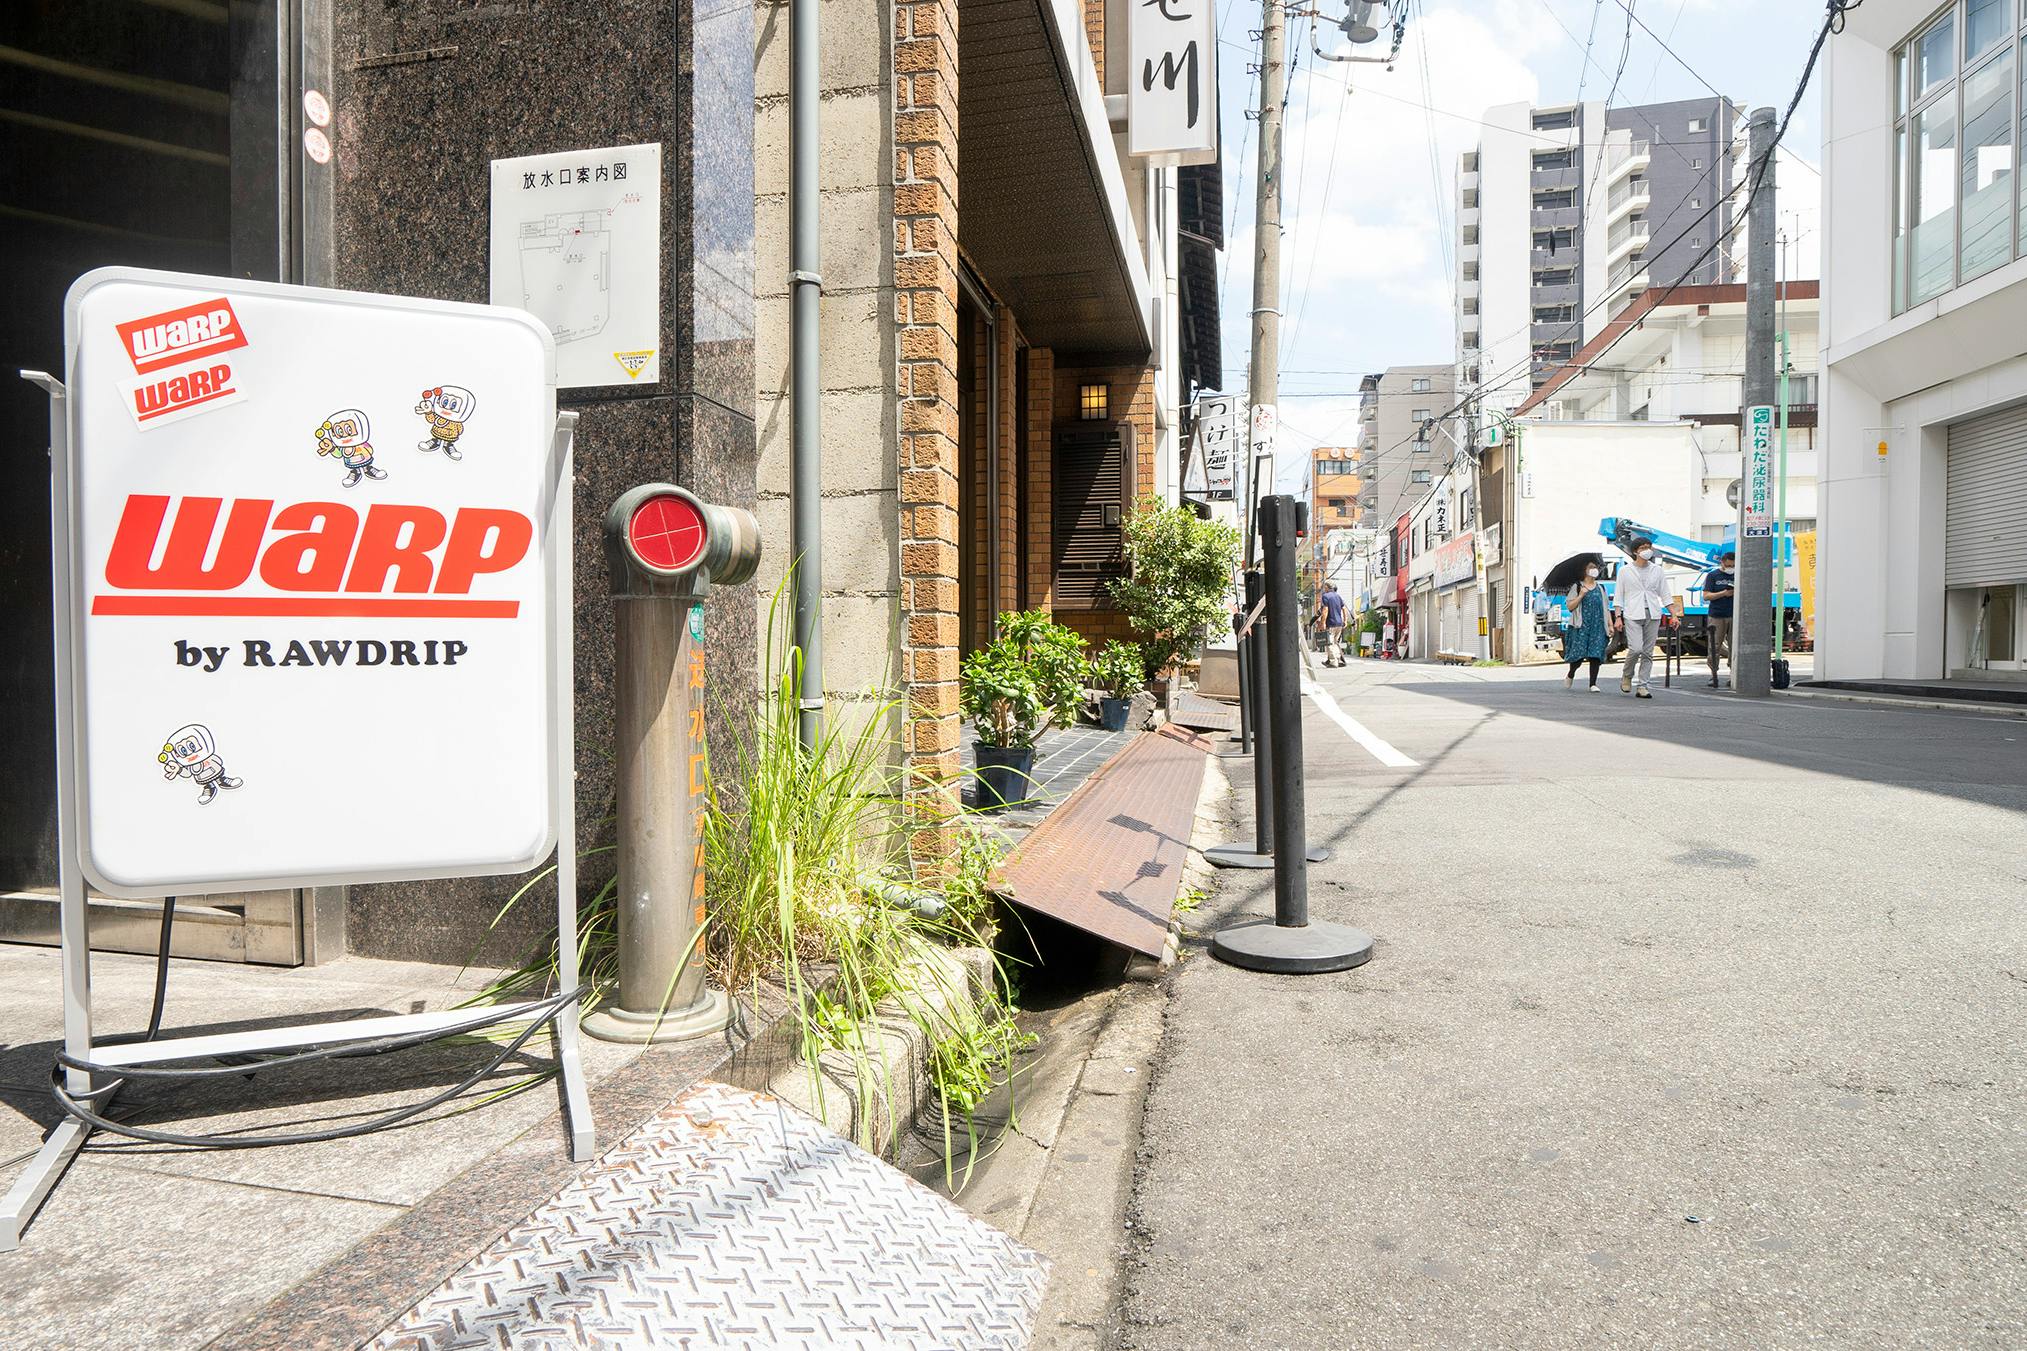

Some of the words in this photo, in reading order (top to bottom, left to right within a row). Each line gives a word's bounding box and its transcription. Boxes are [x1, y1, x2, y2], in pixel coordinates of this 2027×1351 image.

[523, 163, 627, 190] 放水口案内図
[1752, 425, 1767, 513] たわだ泌尿器科
[174, 639, 230, 673] by
[242, 639, 468, 667] RAWDRIP
